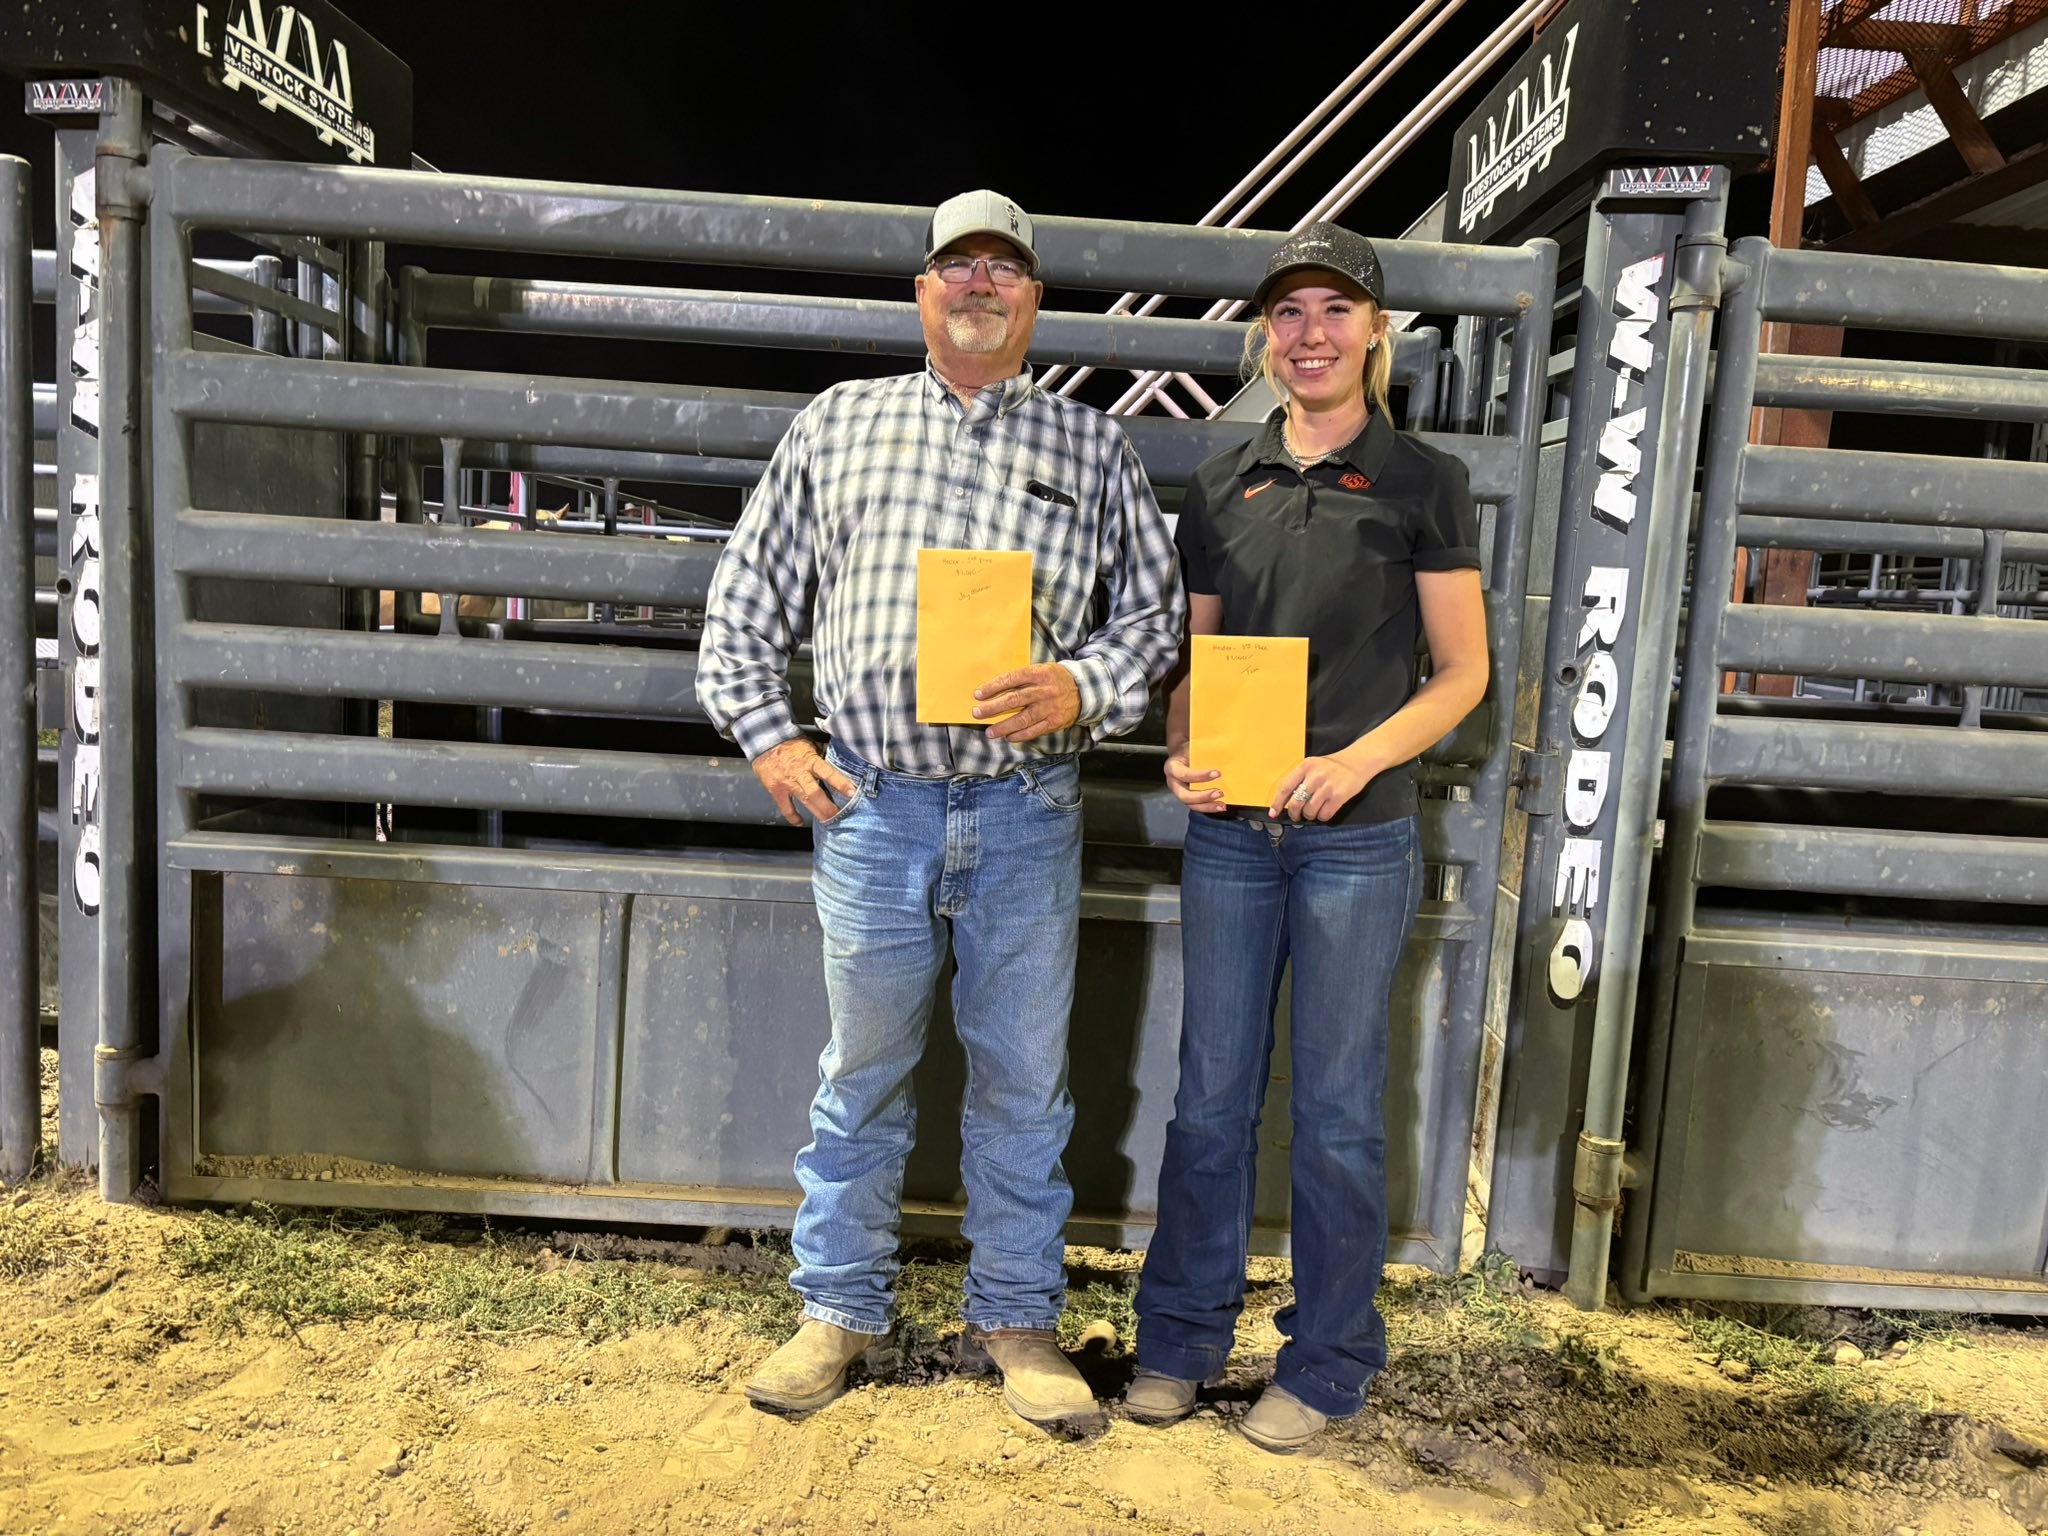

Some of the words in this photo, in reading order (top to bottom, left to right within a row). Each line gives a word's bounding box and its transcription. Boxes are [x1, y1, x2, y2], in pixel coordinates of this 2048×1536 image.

[33, 82, 103, 101] WW
[224, 34, 306, 101] IVESTOCK
[308, 89, 370, 142] SYSTEMS
[1467, 22, 1580, 188] WW
[1466, 151, 1513, 207] LIVESTOCK
[1513, 107, 1561, 163] SYSTEMS
[1621, 166, 1714, 184] WW
[1547, 566, 1630, 1009] RODEO
